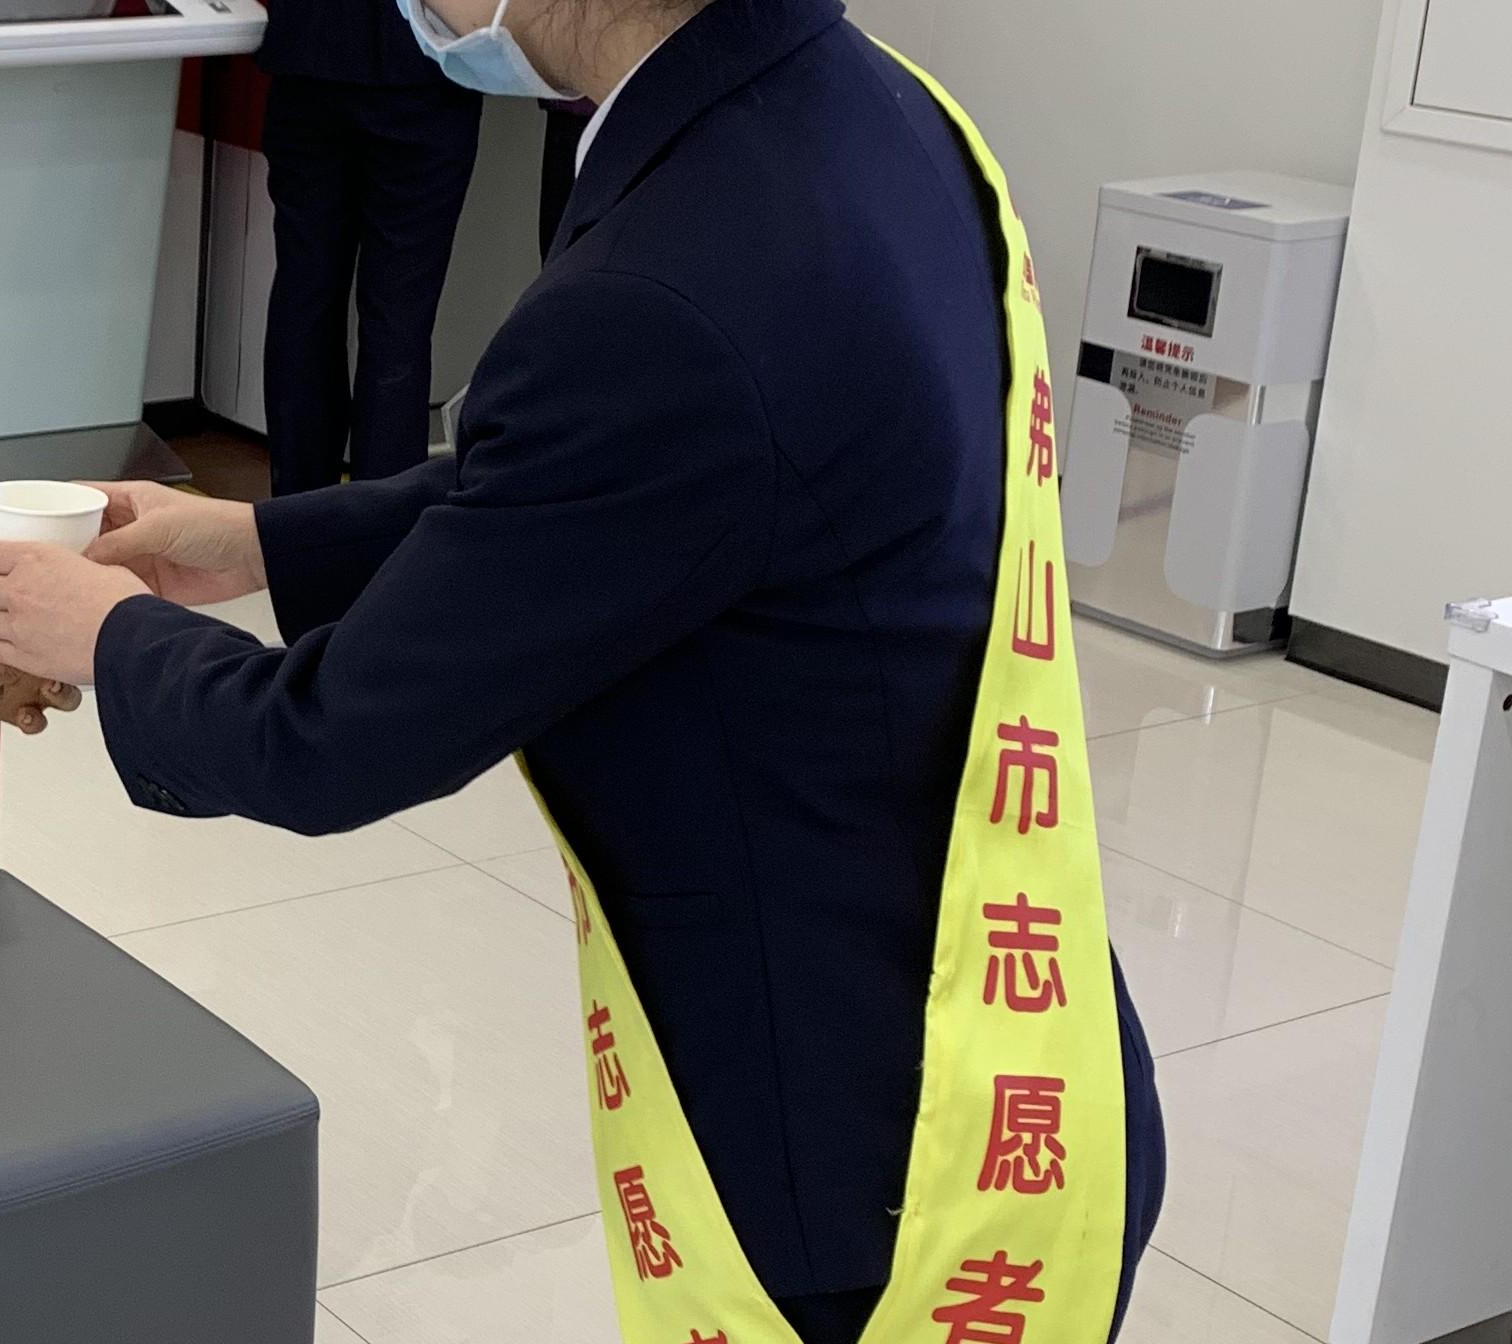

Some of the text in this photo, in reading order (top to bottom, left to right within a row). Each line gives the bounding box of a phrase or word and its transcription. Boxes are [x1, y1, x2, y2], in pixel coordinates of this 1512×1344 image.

[1140, 334, 1194, 362] 温馨提示
[1133, 402, 1183, 426] Reminder
